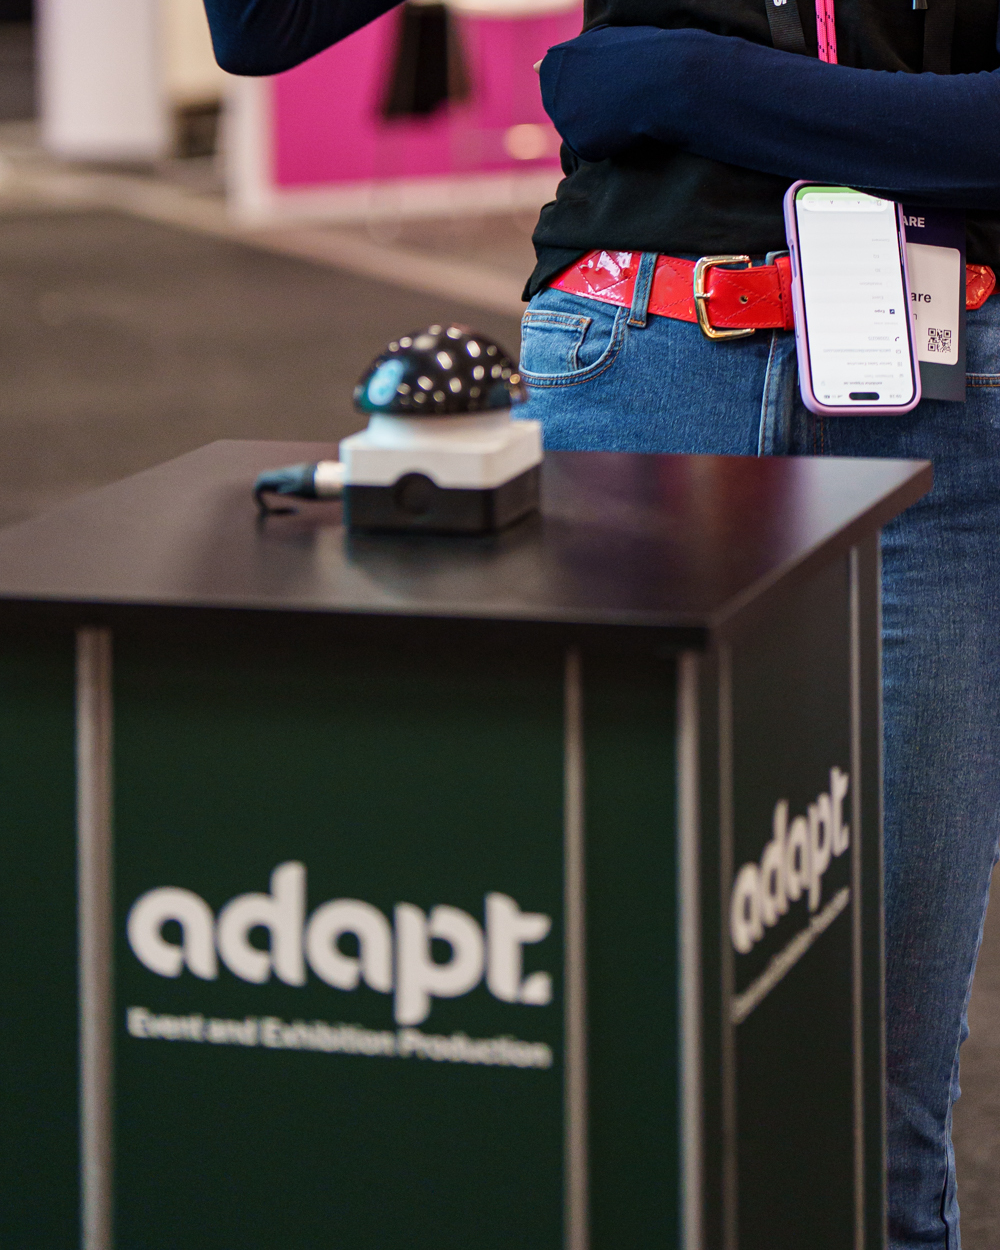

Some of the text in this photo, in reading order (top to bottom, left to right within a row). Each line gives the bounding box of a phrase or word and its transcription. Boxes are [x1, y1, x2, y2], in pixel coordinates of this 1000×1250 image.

[126, 1005, 553, 1070] Event and Exhibition Production
